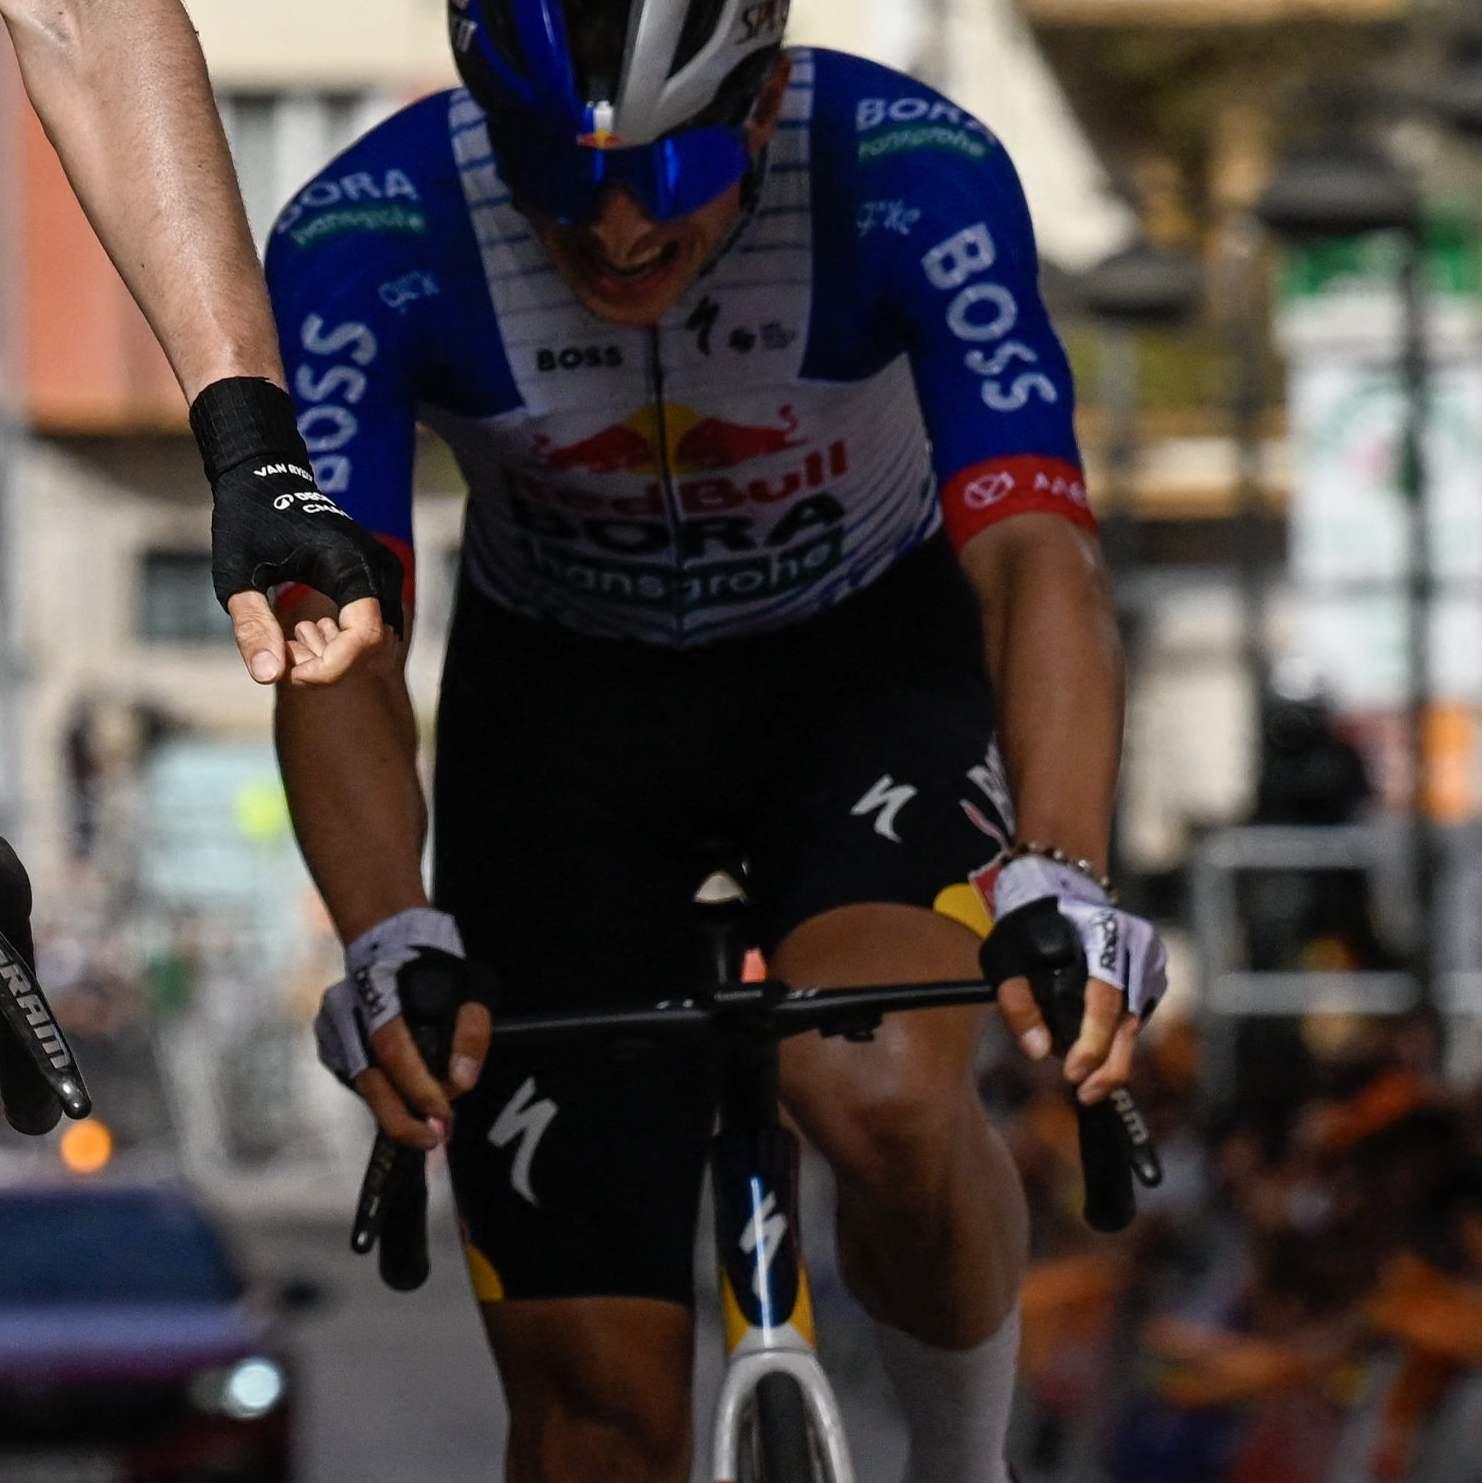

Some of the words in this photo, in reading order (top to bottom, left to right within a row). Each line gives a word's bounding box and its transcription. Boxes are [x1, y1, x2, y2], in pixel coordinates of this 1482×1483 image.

[920, 222, 1059, 412] BOSS
[537, 347, 624, 372] BOSS
[289, 313, 378, 493] BOSS
[254, 463, 287, 477] VAN
[510, 494, 847, 558] BORA
